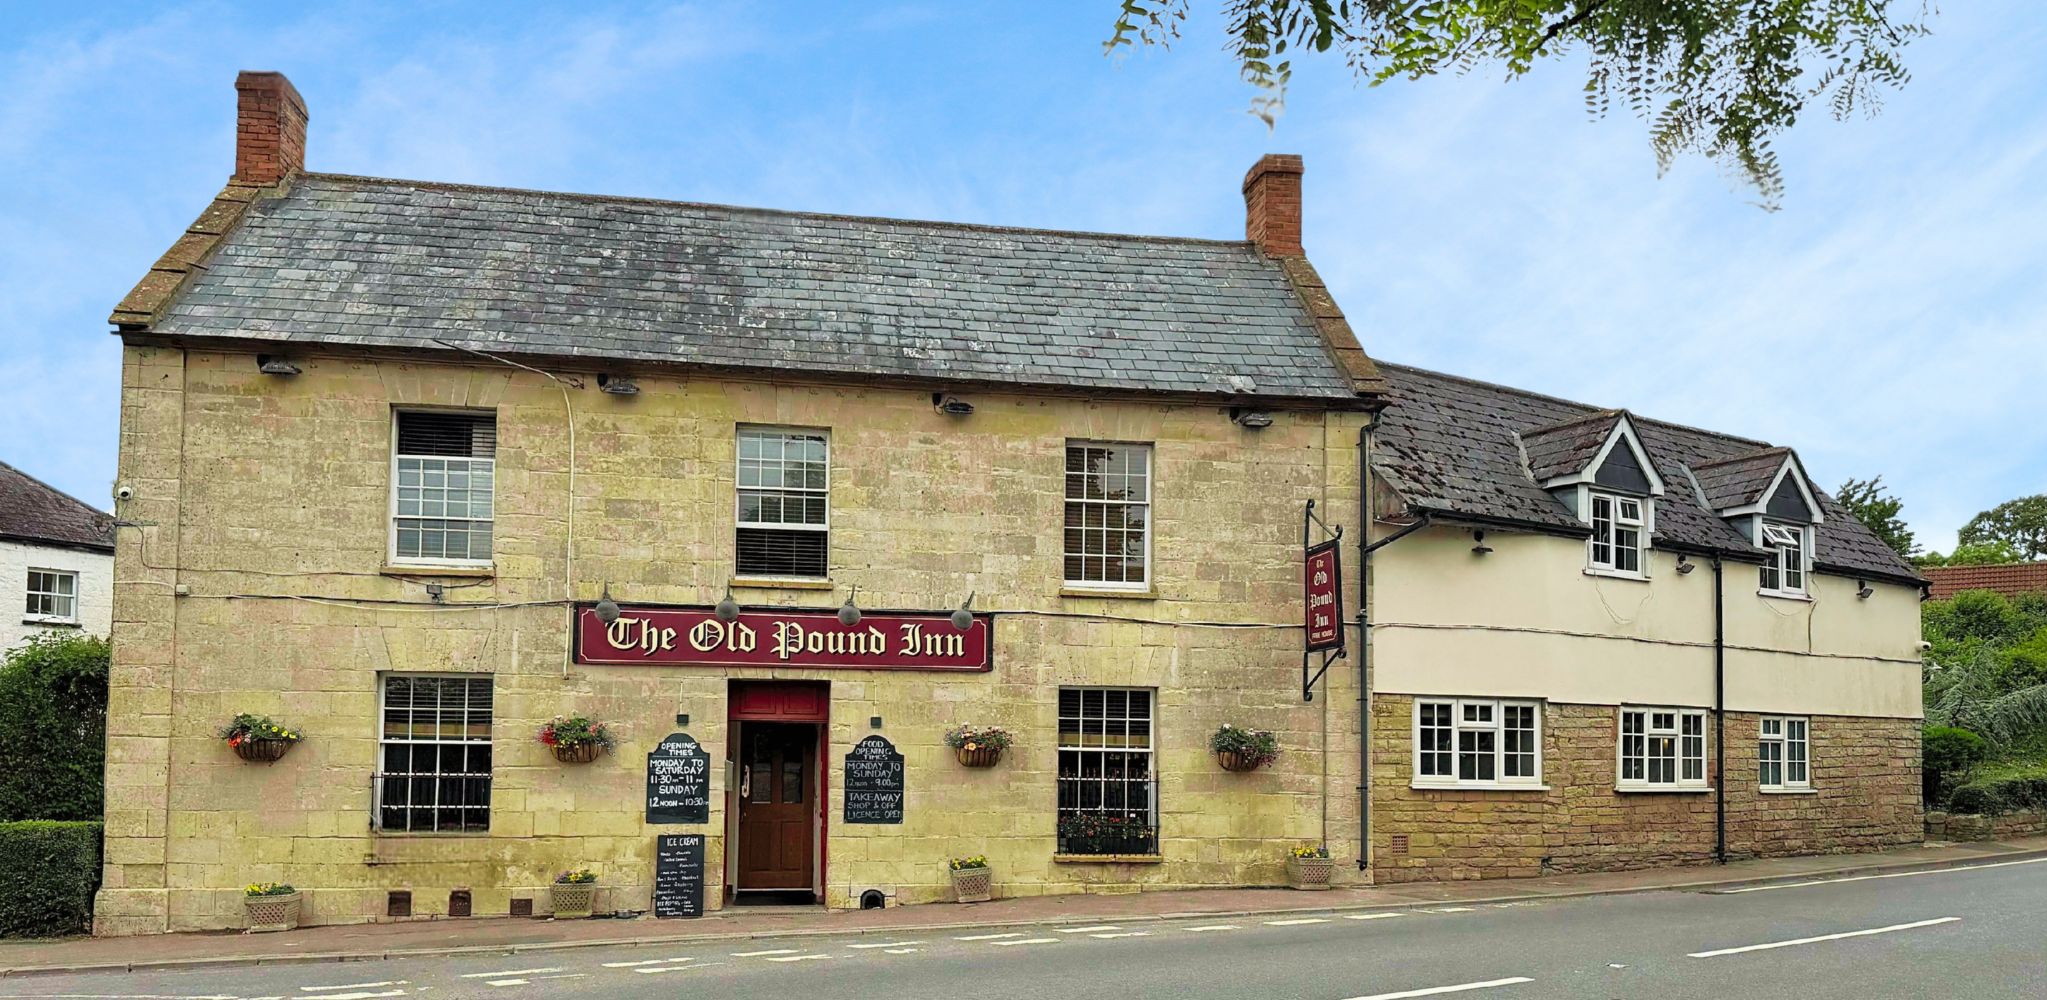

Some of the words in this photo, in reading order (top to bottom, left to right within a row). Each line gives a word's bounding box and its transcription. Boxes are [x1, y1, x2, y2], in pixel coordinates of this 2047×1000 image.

[1313, 570, 1328, 586] Old
[1310, 590, 1333, 611] Pound
[1314, 613, 1329, 628] Inn
[605, 617, 677, 656] The
[688, 618, 757, 654] Old
[769, 620, 887, 660] Pound
[898, 623, 966, 657] Inn
[661, 742, 697, 750] OPENING
[862, 740, 884, 748] FOOD
[855, 747, 892, 755] OPENING
[649, 759, 685, 767] MONDAY
[691, 759, 704, 767] TO
[847, 762, 883, 770] MONDAY
[889, 762, 901, 772] TO
[655, 766, 704, 775] SATURDAY
[853, 769, 892, 778] SUNDAY
[658, 785, 698, 795] SUNDAY
[848, 793, 901, 803] TAKEAWAY
[847, 810, 880, 820] LICENCE
[666, 837, 677, 847] ICE
[679, 837, 699, 846] CREAM
